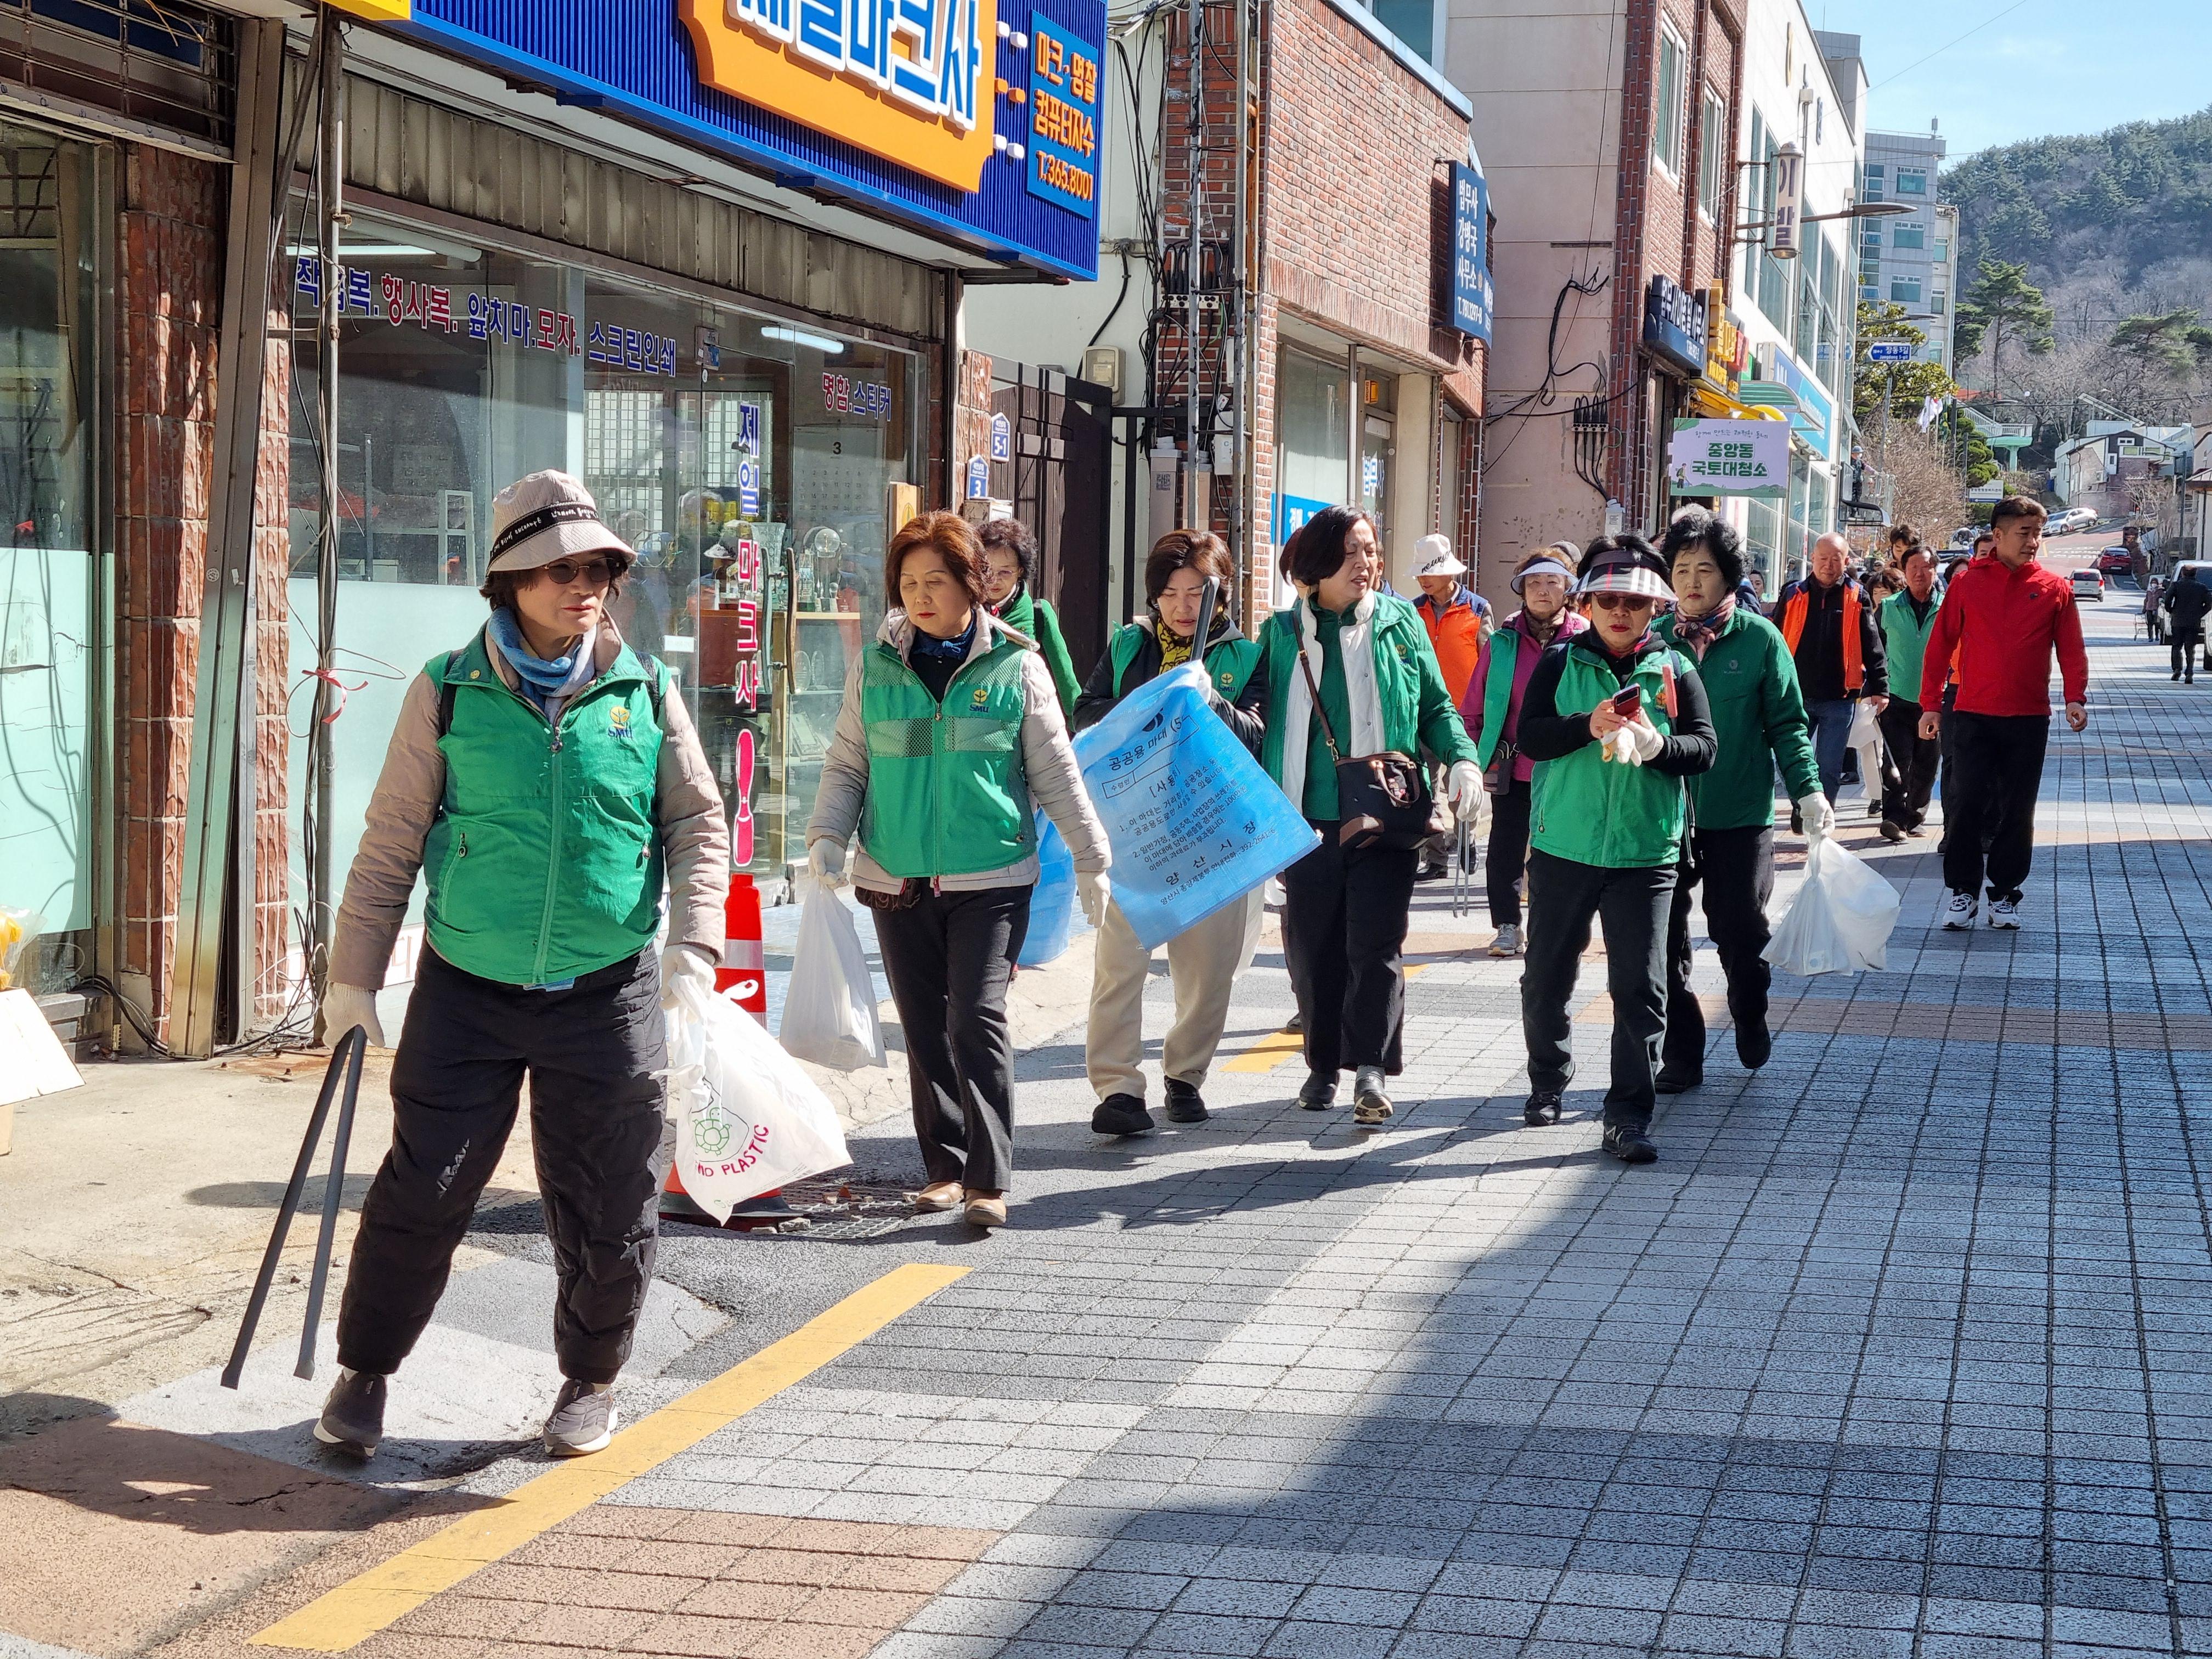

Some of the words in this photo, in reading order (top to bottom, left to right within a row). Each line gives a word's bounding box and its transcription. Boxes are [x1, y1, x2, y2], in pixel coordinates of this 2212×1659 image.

[1033, 88, 1094, 157] 컴퓨터자수
[1036, 150, 1093, 201] T.365.8001
[1458, 178, 1479, 219] 법무사
[1457, 217, 1478, 257] 강병국
[1457, 255, 1477, 290] 사무소
[589, 321, 676, 378] 스크린인쇄
[1886, 346, 1909, 354] 장동3길
[832, 441, 842, 455] 3
[994, 436, 1007, 455] 5-1
[1708, 442, 1754, 459] 중앙동
[1691, 460, 1768, 477] 국토대청소
[974, 479, 982, 498] 3
[969, 704, 989, 713] SMU
[1109, 744, 1145, 771] 공공용
[1148, 727, 1167, 749] 마대
[1111, 778, 1130, 791] 수령인
[1129, 817, 1137, 826] 이
[1138, 806, 1161, 821] 마대는
[1192, 797, 1215, 819] 사업장의
[1152, 844, 1173, 860] 마대에
[1173, 835, 1187, 848] 담아
[1201, 804, 1226, 824] 경우에는
[1149, 856, 1170, 872] 이하의
[1170, 840, 1197, 860] 과태료가
[1160, 889, 1180, 905] 양산시
[1211, 851, 1237, 870] 안내전화
[721, 1124, 770, 1175] PLASTIC
